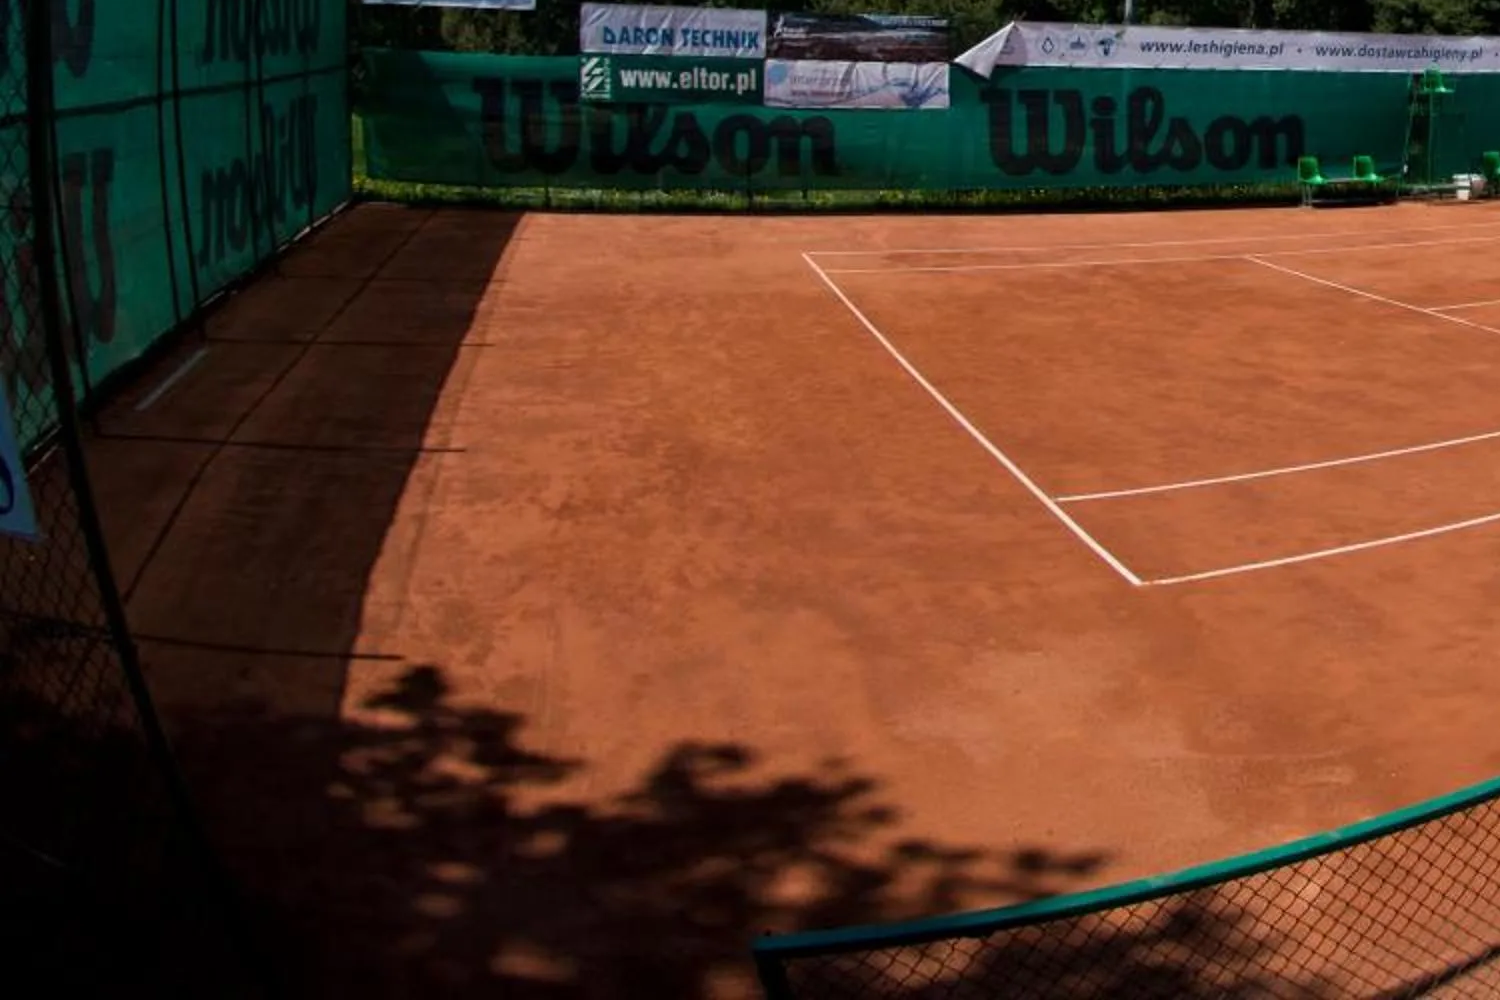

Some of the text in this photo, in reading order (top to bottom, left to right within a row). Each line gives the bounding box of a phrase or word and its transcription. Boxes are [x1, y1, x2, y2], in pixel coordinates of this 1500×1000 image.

[602, 26, 675, 47] DARON
[680, 28, 761, 49] TECHNIK
[1140, 40, 1284, 58] www.leshigiena.pl
[620, 65, 757, 95] www.eltor.pl
[474, 76, 841, 178] Wilson
[979, 87, 1305, 176] Wilson
